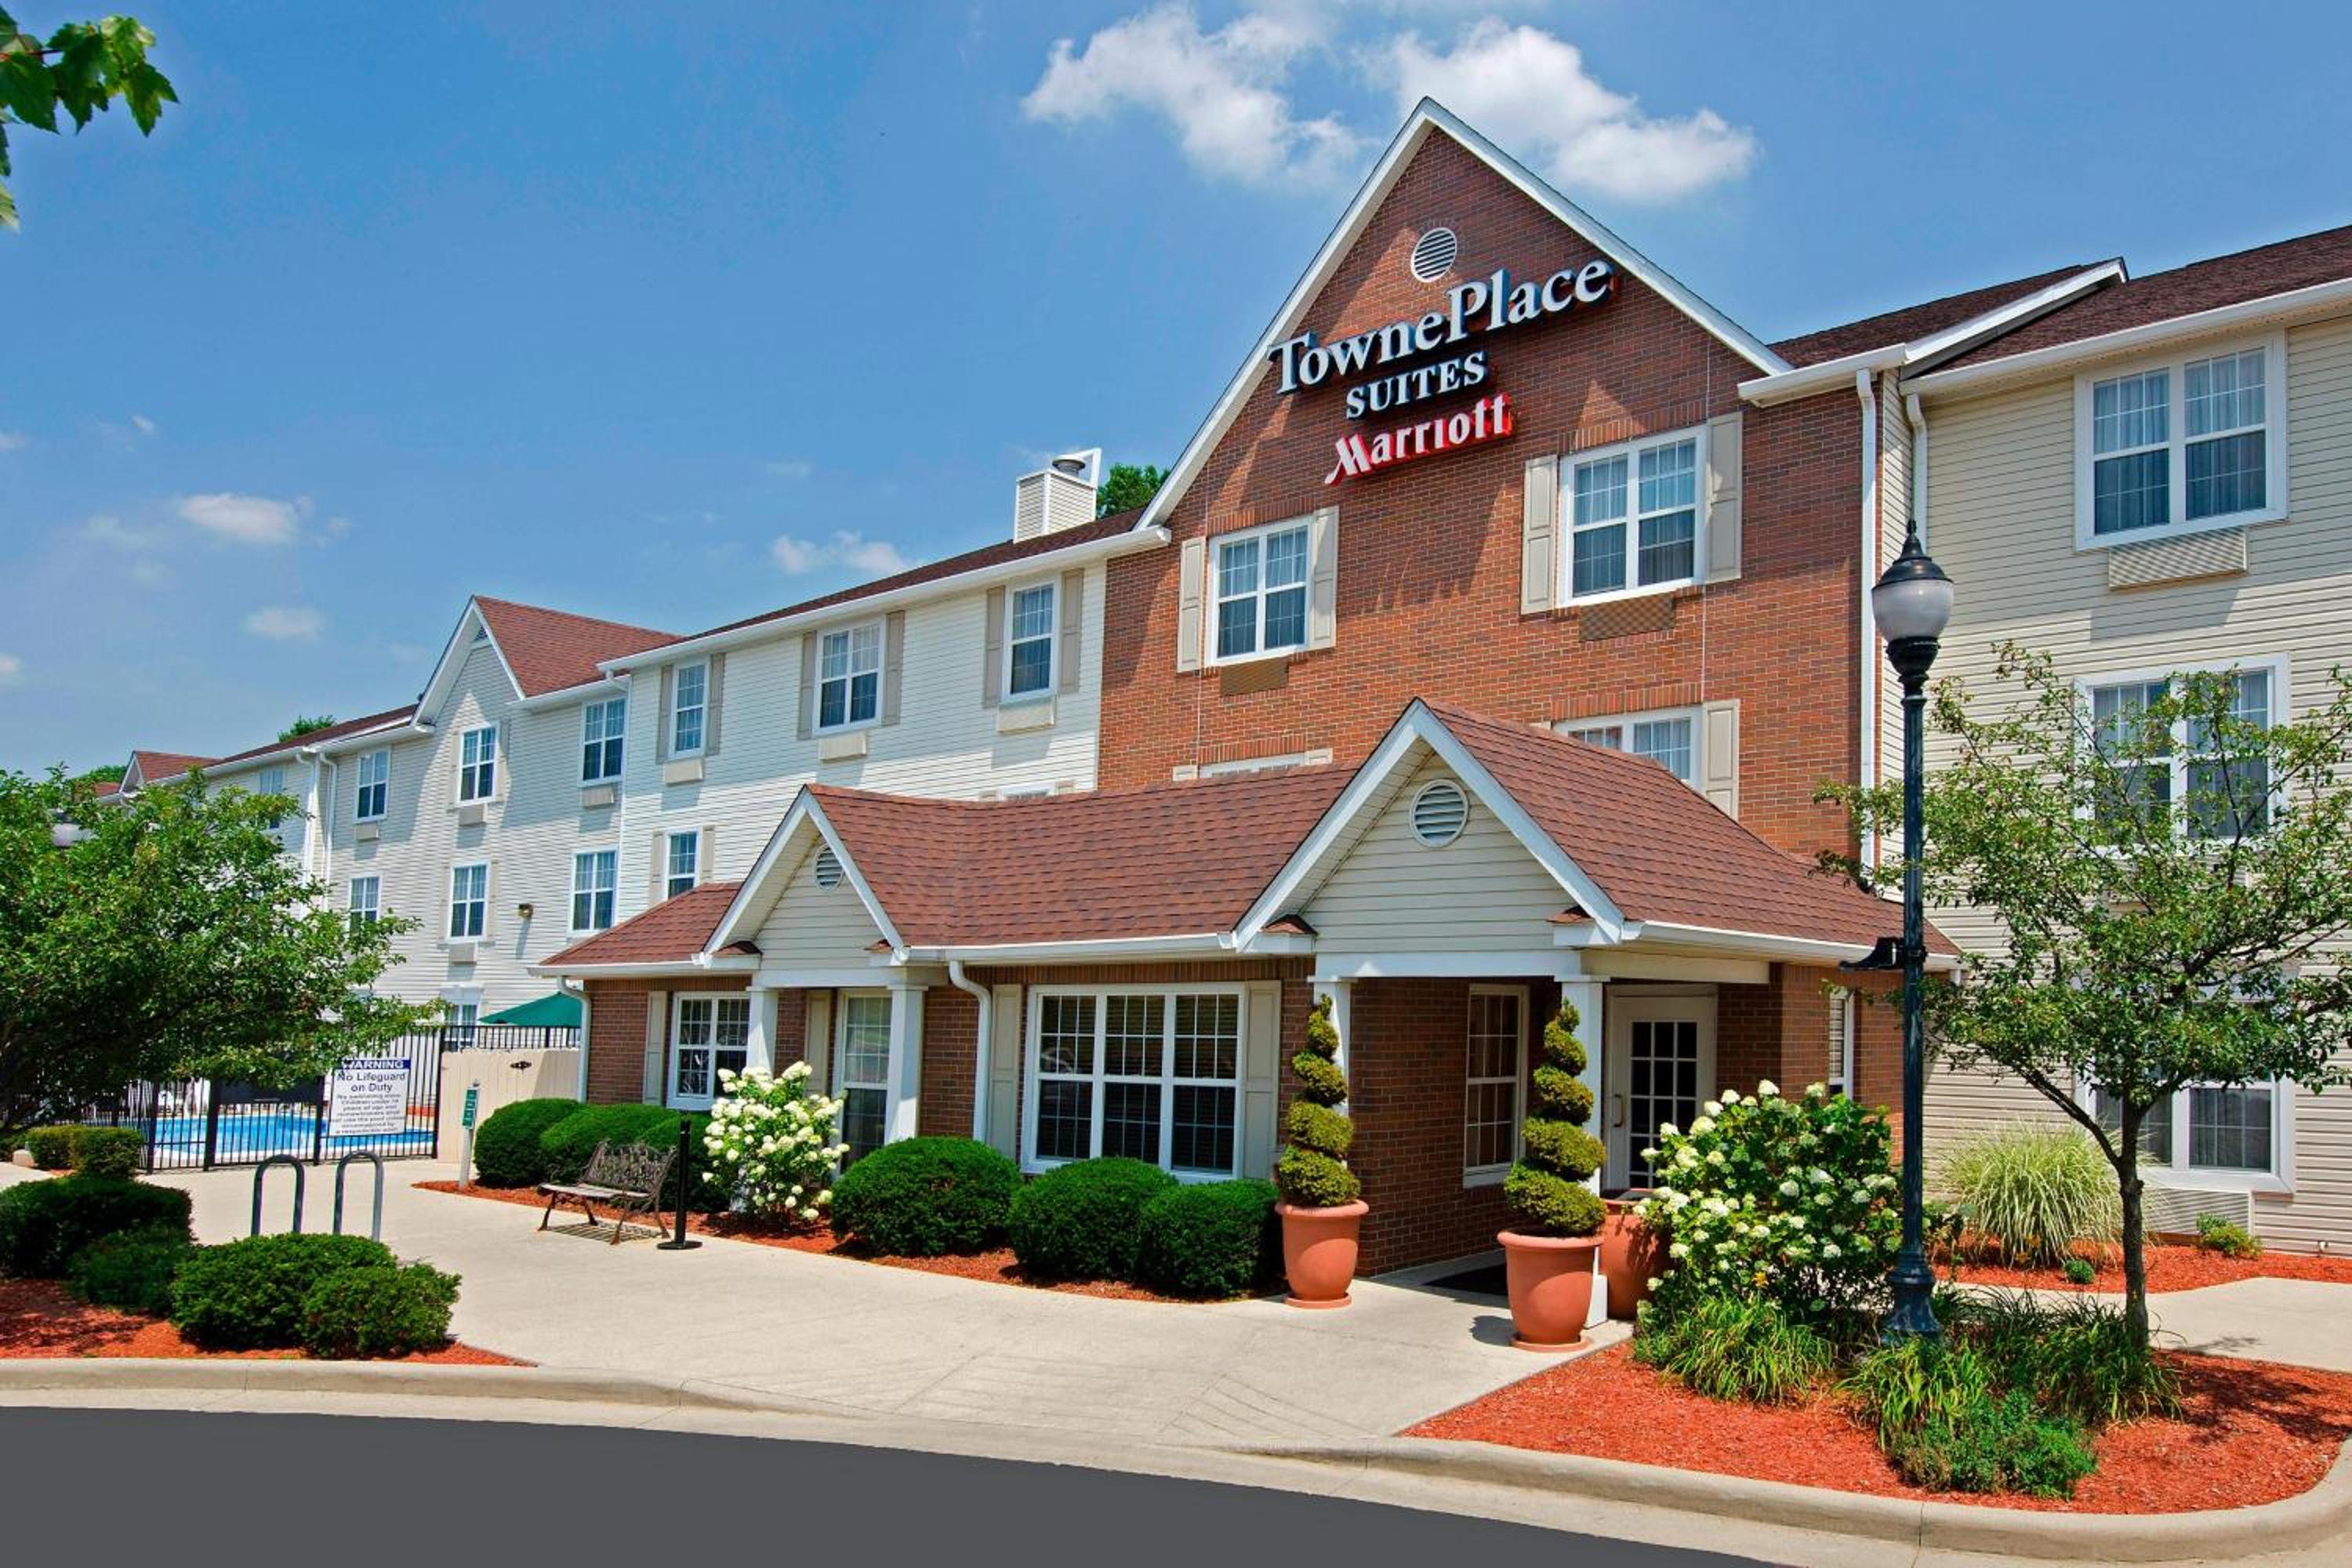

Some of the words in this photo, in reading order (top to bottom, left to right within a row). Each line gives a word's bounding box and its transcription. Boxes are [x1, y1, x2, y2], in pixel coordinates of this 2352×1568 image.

[1267, 260, 1614, 394] TownePlace
[1345, 350, 1490, 420] SUITES
[1325, 392, 1514, 485] Marriott
[337, 1072, 353, 1081] No
[357, 1072, 405, 1082] Lifeguard
[342, 1059, 404, 1069] WARNING
[368, 1083, 393, 1093] Duty
